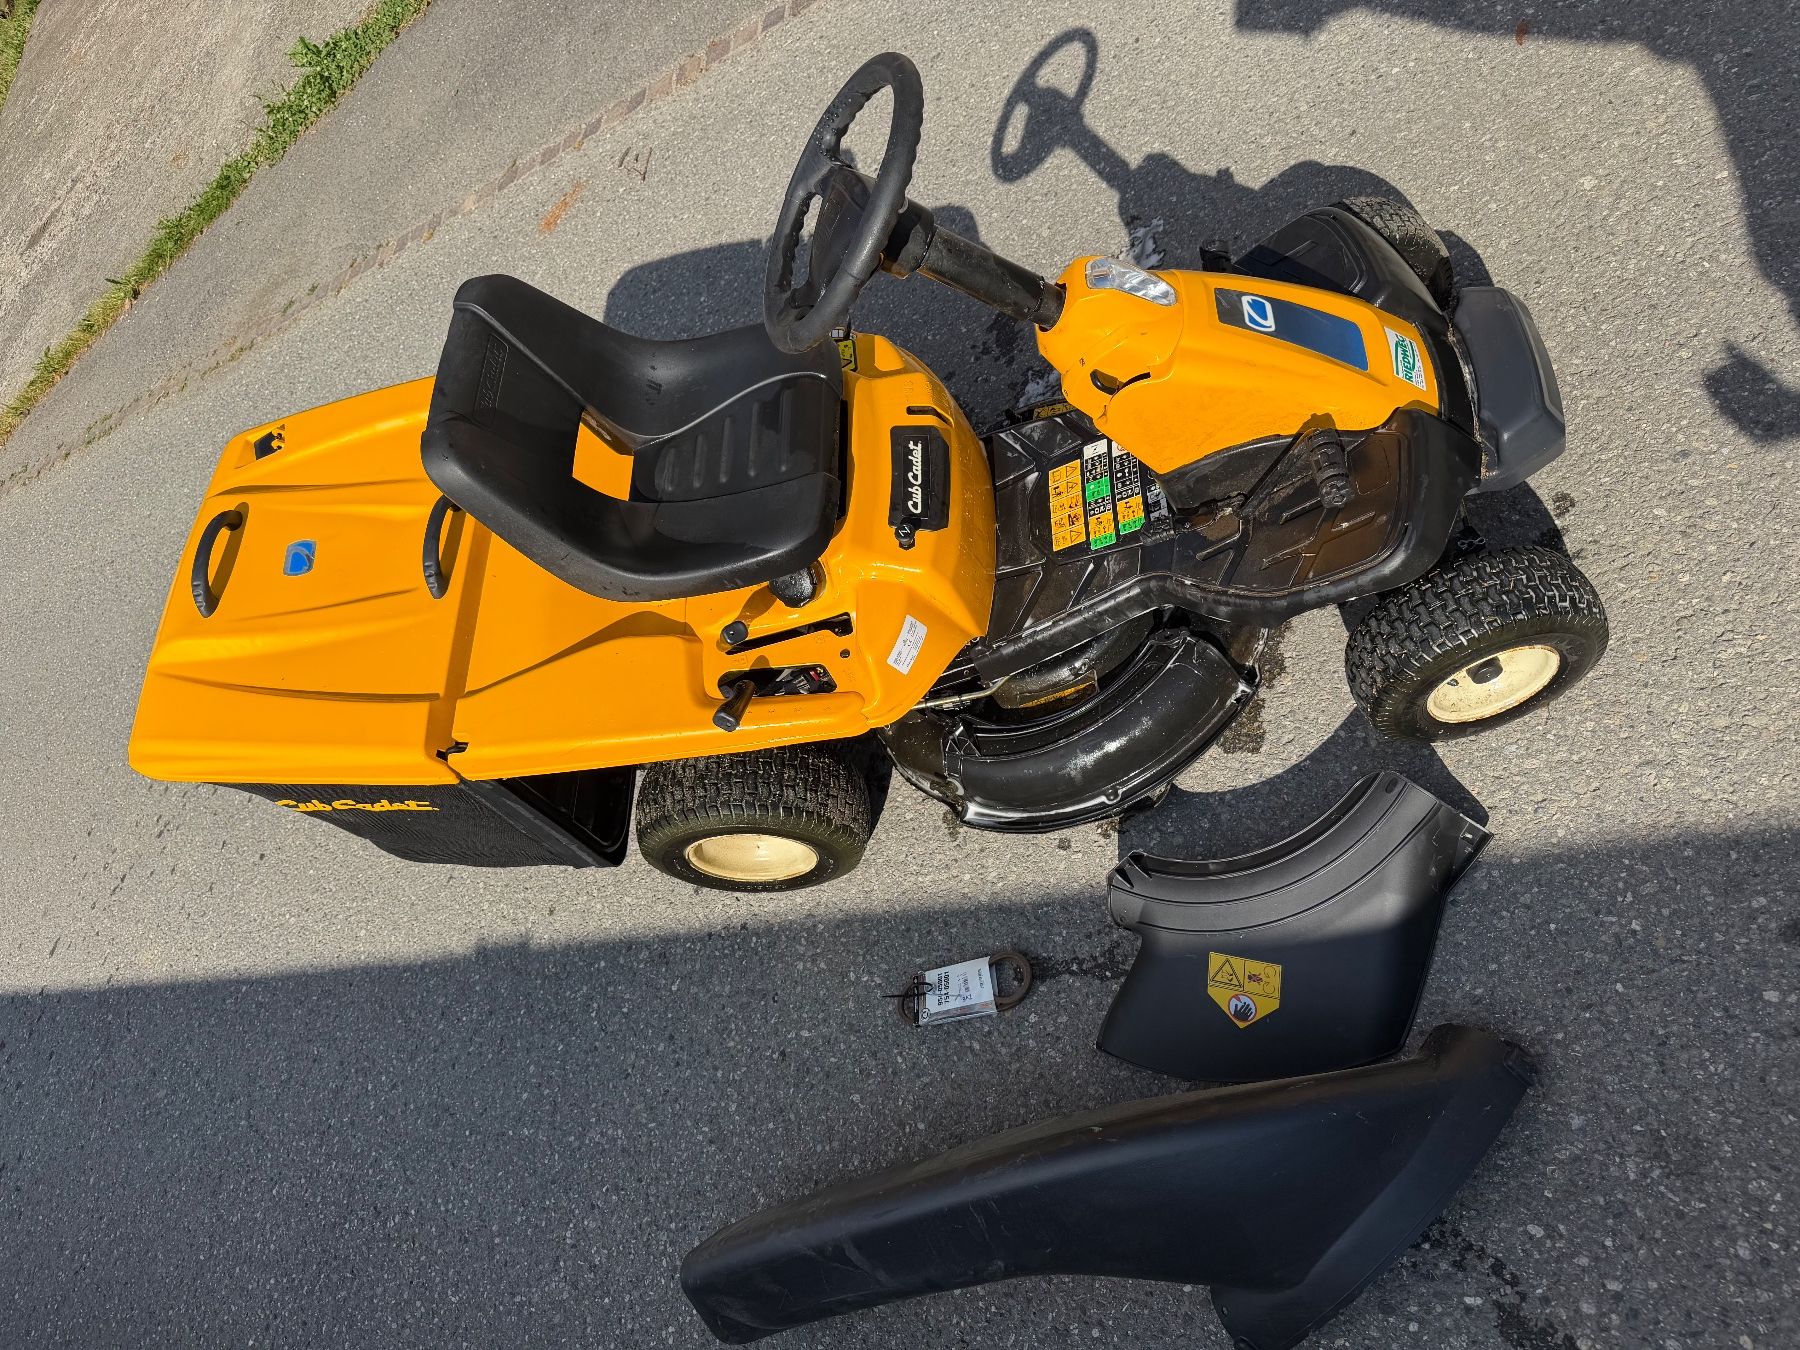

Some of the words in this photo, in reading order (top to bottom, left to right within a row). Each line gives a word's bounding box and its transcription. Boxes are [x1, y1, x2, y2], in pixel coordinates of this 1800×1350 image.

[907, 440, 922, 485] Cadet
[907, 485, 922, 514] Cub
[274, 799, 333, 812] Cub
[332, 799, 434, 812] Cadet
